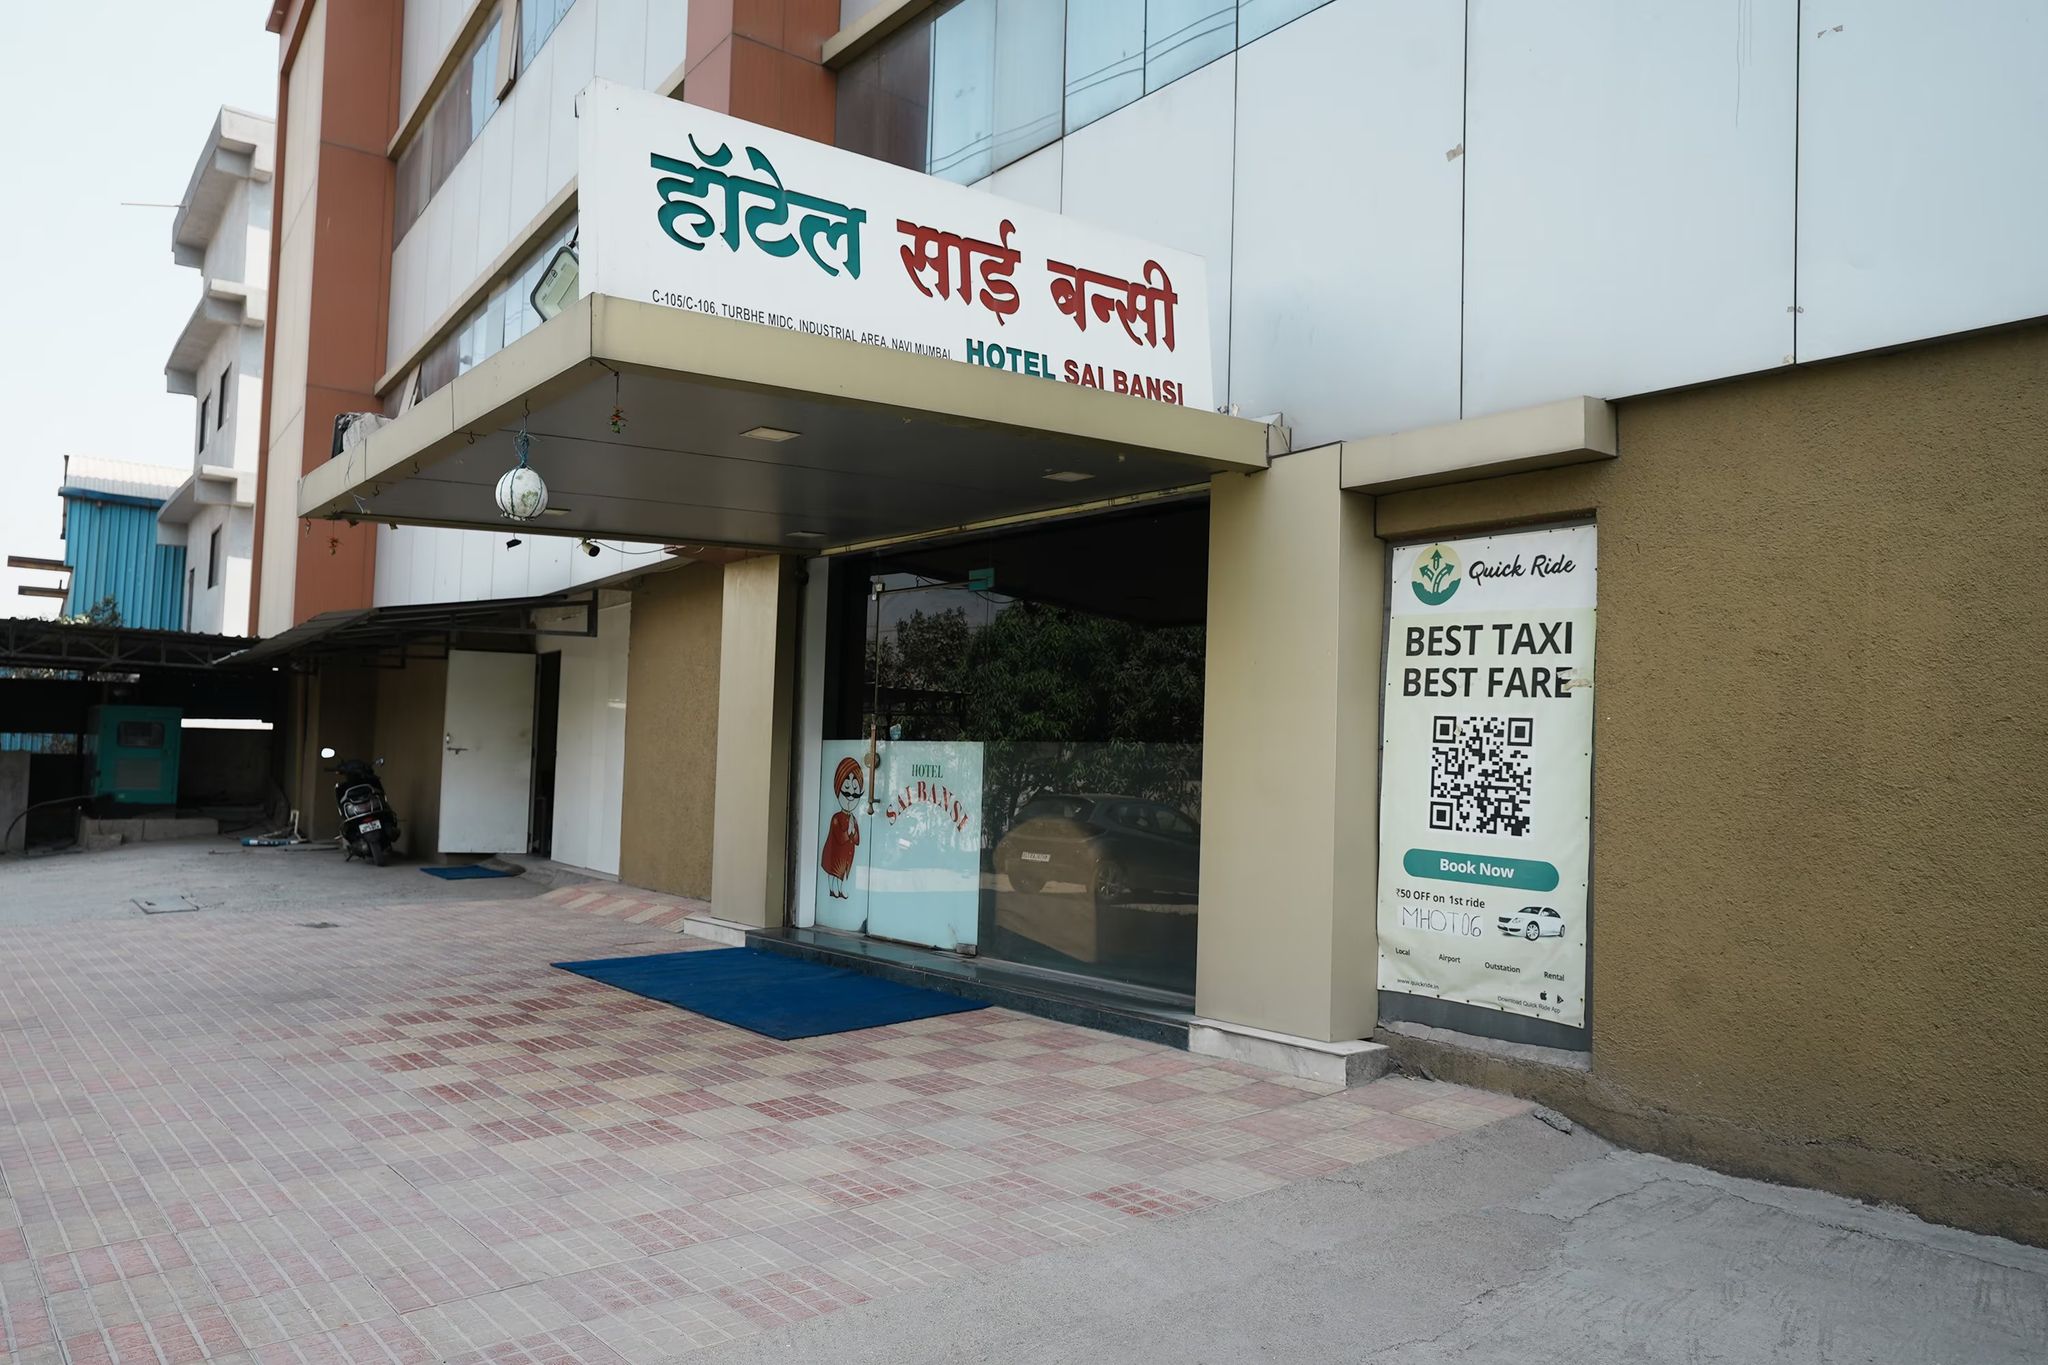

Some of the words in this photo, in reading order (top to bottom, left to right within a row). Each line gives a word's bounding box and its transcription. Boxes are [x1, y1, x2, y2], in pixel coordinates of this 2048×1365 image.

[651, 133, 867, 280] हॉटेल
[896, 219, 1022, 326] साई
[1047, 259, 1178, 352] बन्सी
[721, 303, 765, 324] TURBHE
[799, 319, 858, 342] INDUSTRIAL
[891, 338, 912, 353] NAVI
[966, 338, 1056, 381] HOTEL
[1064, 359, 1105, 391] SAI
[1113, 369, 1184, 406] BANSI
[1469, 554, 1526, 586] Quick
[1530, 554, 1576, 578] Ride
[1405, 624, 1484, 657] BEST
[1492, 621, 1573, 655] TAXI
[1403, 667, 1478, 697] BEST
[1487, 666, 1573, 698] FARE
[911, 763, 943, 779] HOTEL
[886, 785, 913, 826] SAI
[917, 780, 969, 833] BANSI
[1440, 858, 1476, 875] Book
[1480, 862, 1515, 879] Now
[1413, 890, 1431, 901] OFF
[1432, 894, 1445, 904] on
[1449, 895, 1464, 906] 1st
[1466, 897, 1486, 909] ride
[1402, 906, 1482, 938] MHOT06
[1395, 947, 1410, 957] Local
[1438, 953, 1461, 965] Airport
[1484, 961, 1521, 974] Outstation
[1543, 971, 1565, 982] Rental
[1522, 1000, 1538, 1009] Quick
